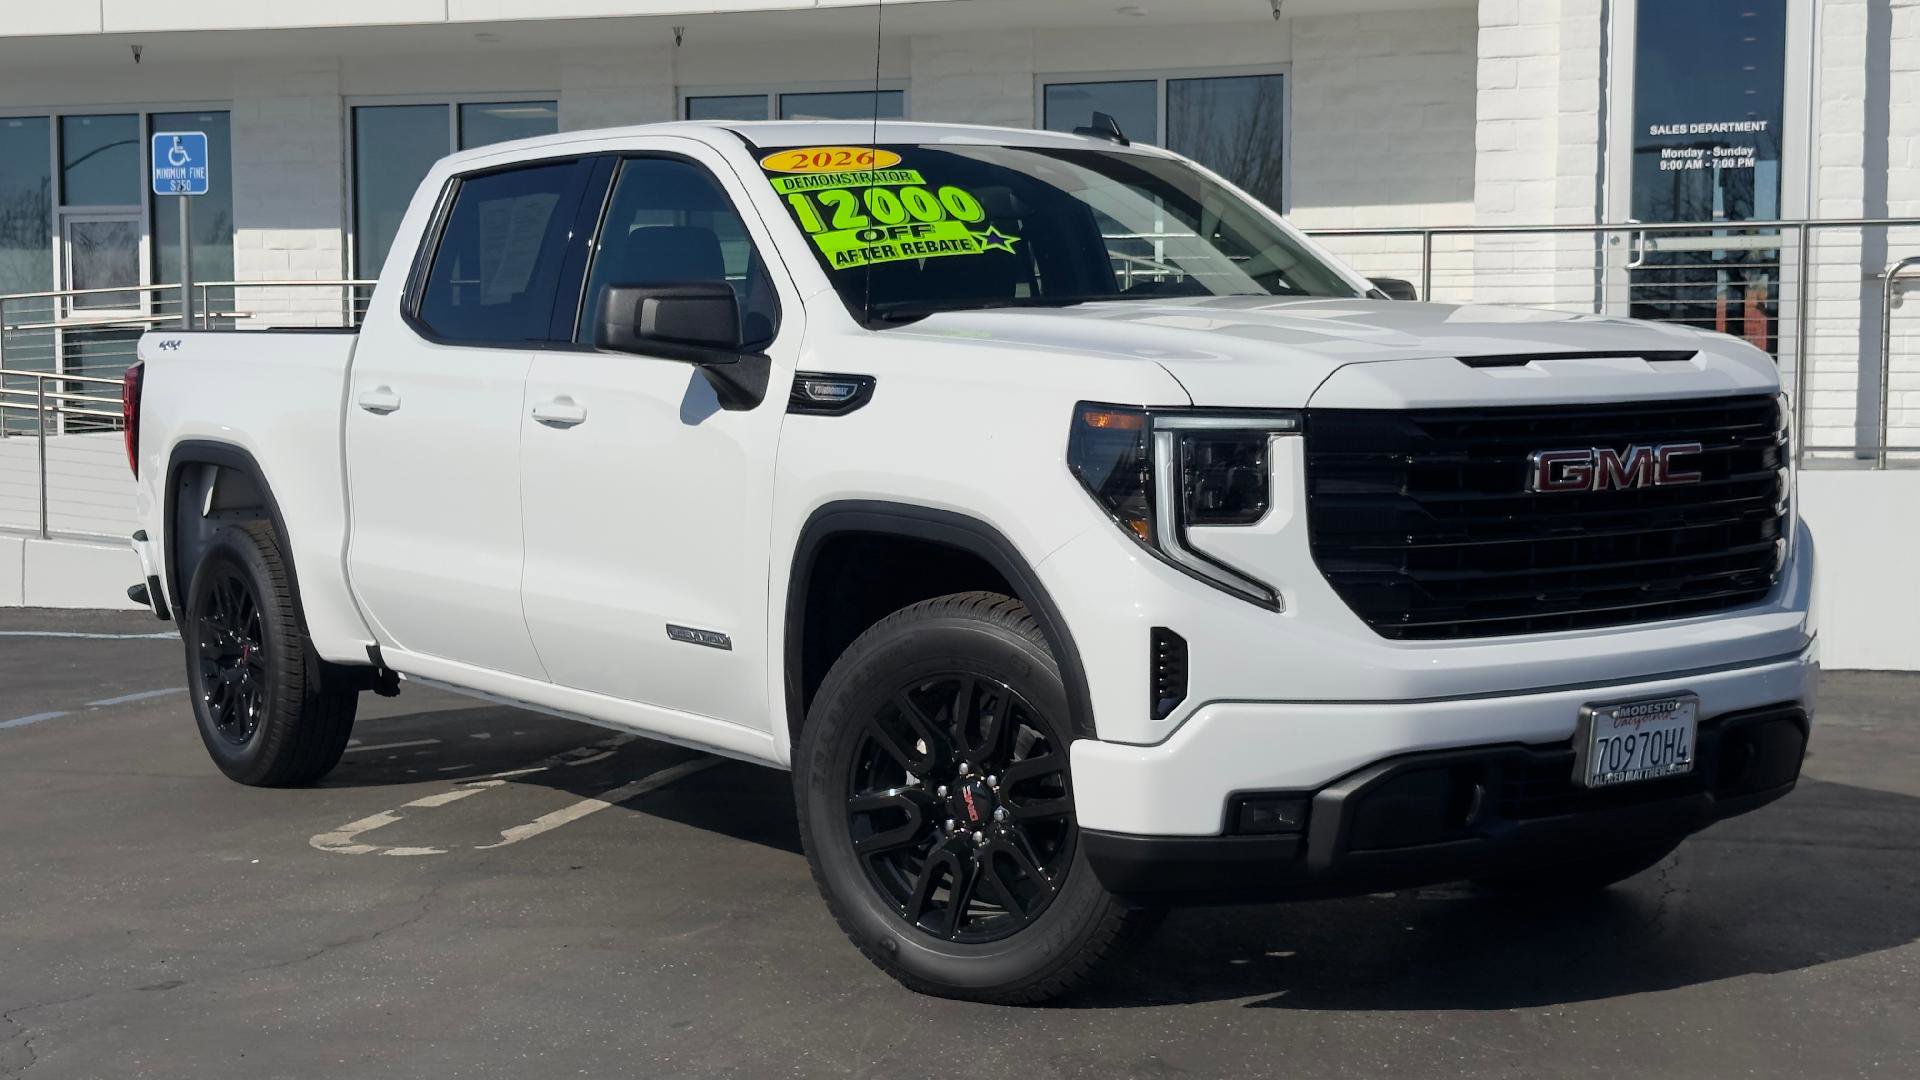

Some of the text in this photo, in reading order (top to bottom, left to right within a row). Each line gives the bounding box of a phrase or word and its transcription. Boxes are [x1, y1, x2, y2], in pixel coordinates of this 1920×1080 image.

[1650, 121, 1767, 136] SALES DEPARTMENT
[791, 152, 875, 169] 2026
[1661, 148, 1704, 160] Monday
[1712, 146, 1754, 158] Sunday
[1660, 160, 1683, 171] 9:00
[1685, 159, 1702, 170] AM
[1712, 158, 1735, 169] 7:00
[1737, 157, 1755, 168] PM
[156, 167, 205, 179] MINIMUM FINE
[783, 170, 912, 191] DEMONSTRATOR
[170, 180, 191, 191] $250
[788, 186, 985, 233] 12000
[855, 224, 936, 243] OFF
[835, 239, 971, 266] AFTER REBATE
[1526, 443, 1702, 493] GMC
[1620, 702, 1676, 715] MODESTO
[1597, 727, 1687, 771] 70970H4
